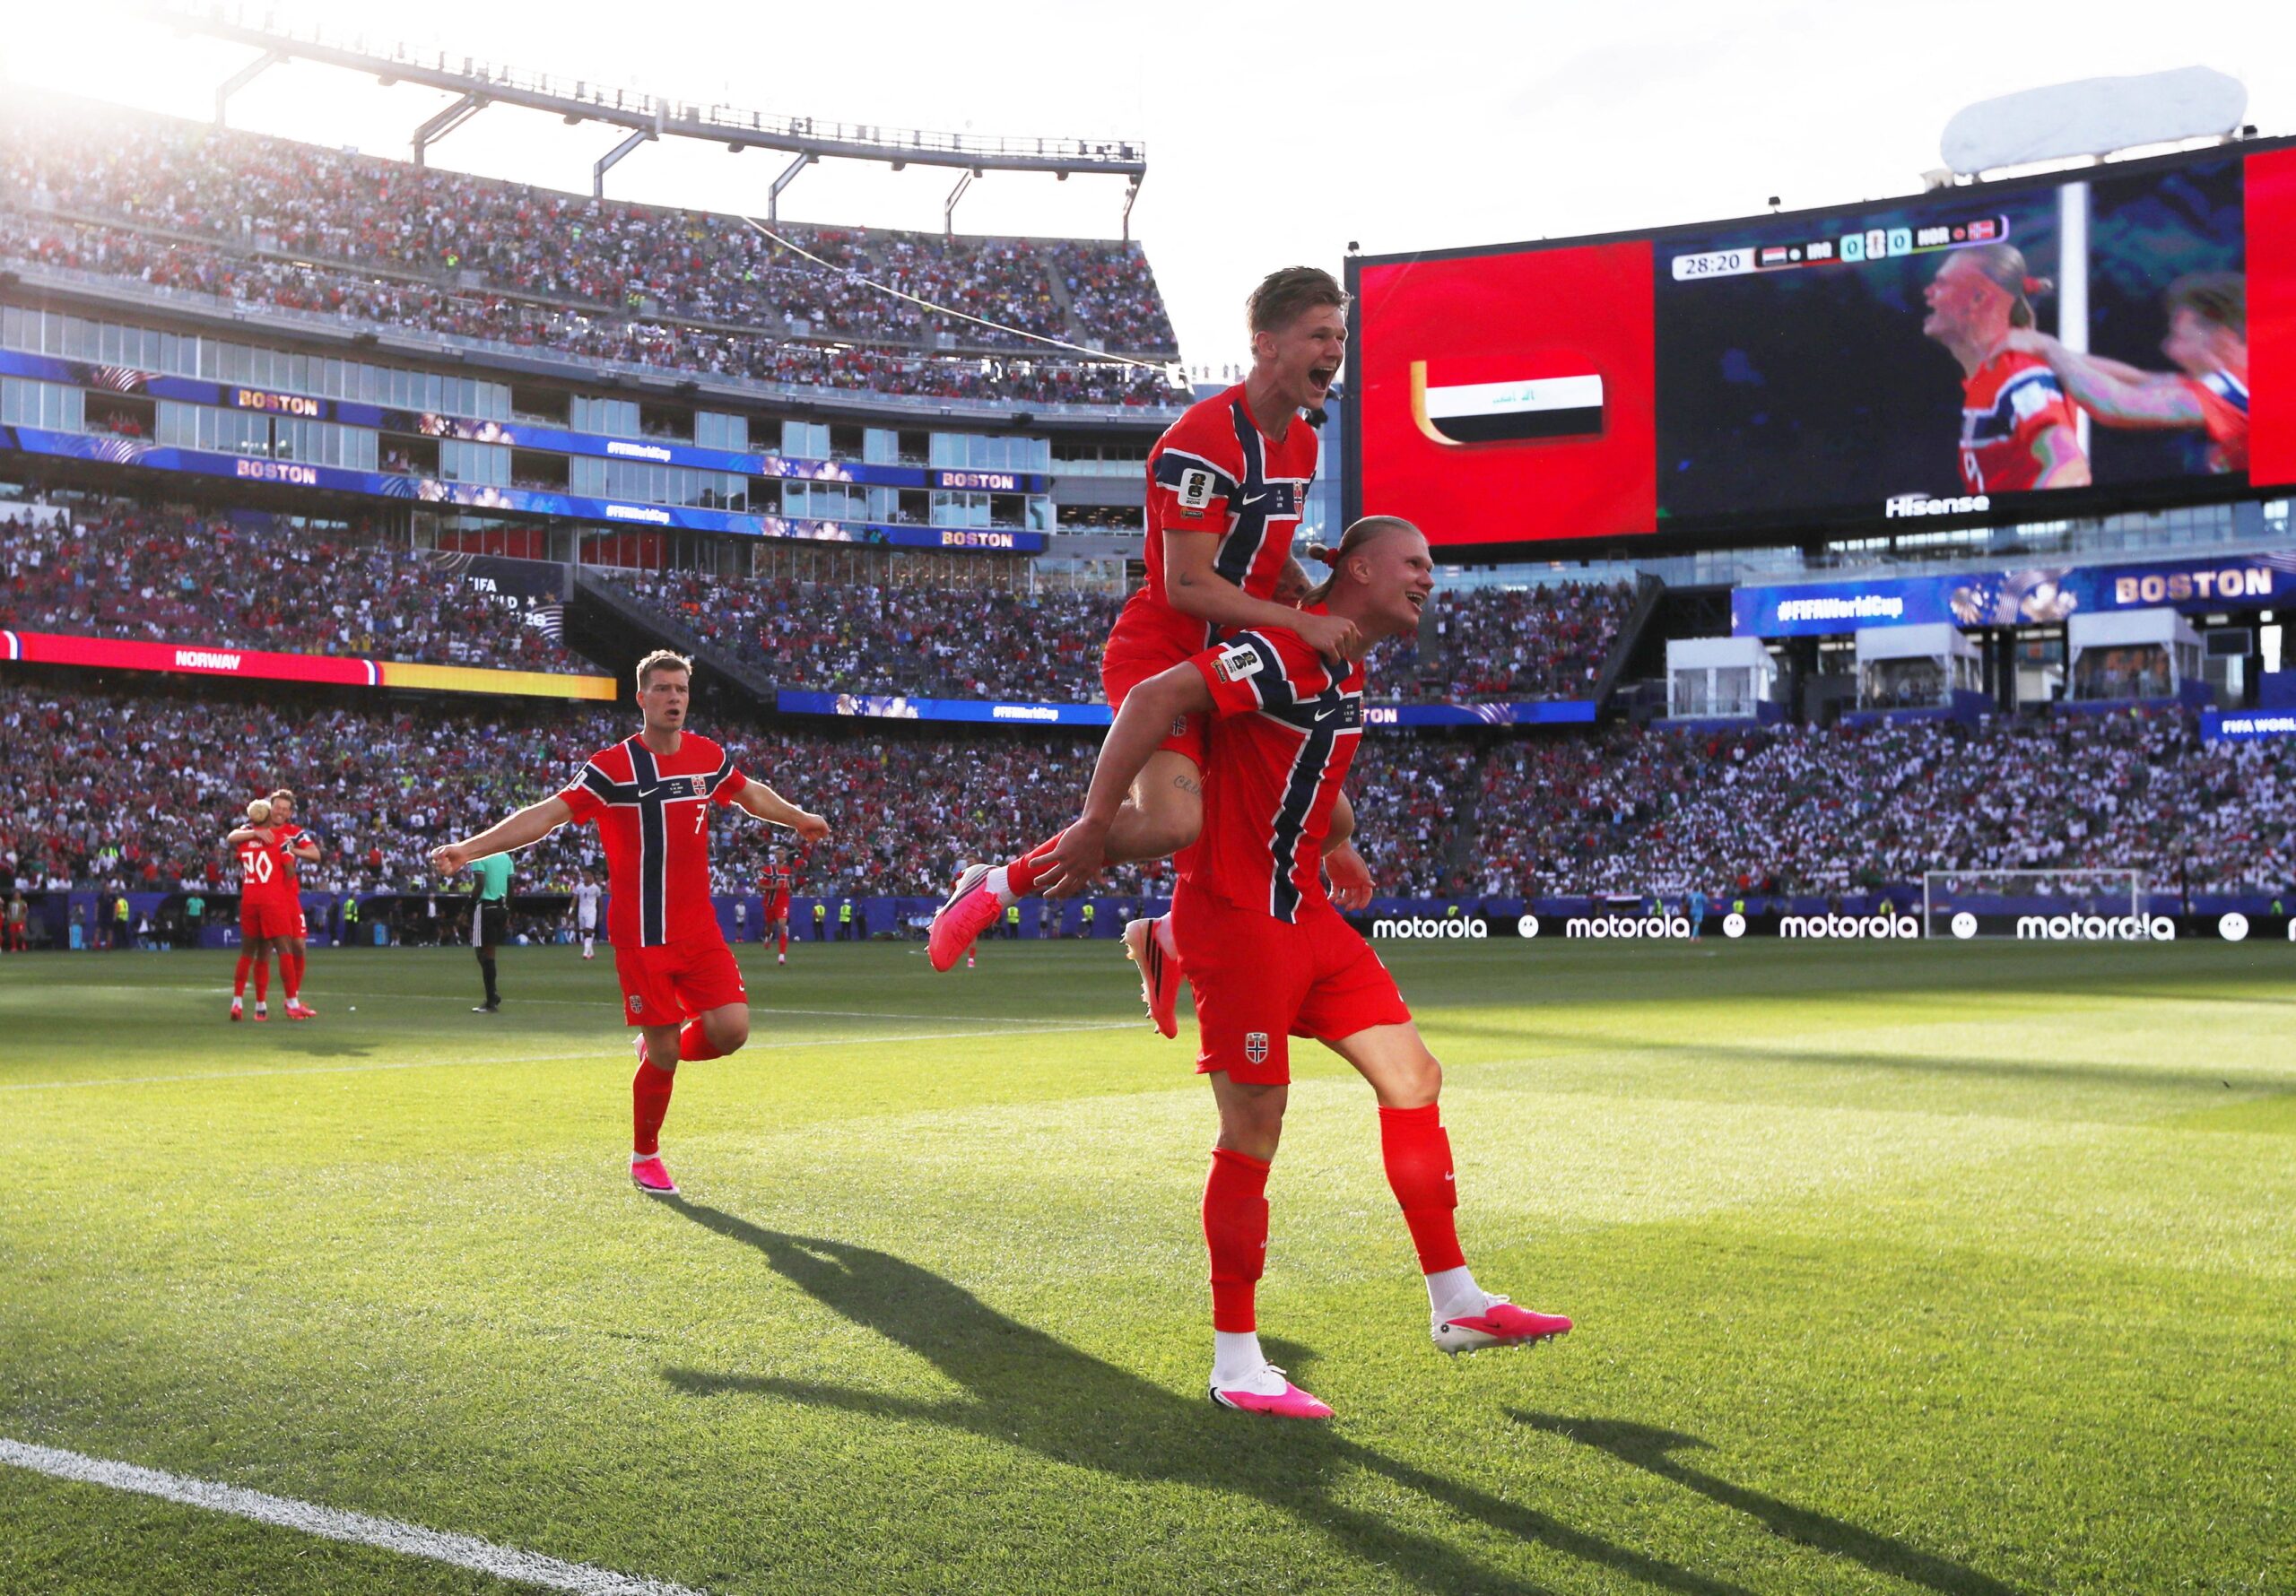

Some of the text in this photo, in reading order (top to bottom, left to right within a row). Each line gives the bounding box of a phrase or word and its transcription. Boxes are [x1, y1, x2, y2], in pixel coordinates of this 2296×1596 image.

[1685, 254, 1740, 274] 28:20
[239, 389, 318, 416] BOSTON
[237, 459, 317, 484] BOSTON
[943, 473, 1013, 489] BOSTON
[1885, 496, 1990, 517] Hisense
[942, 530, 1013, 547] BOSTON
[468, 577, 498, 593] IFA
[2116, 567, 2273, 604] BOSTON
[175, 650, 241, 671] NORWAY
[1363, 707, 1397, 724] TON
[2222, 716, 2296, 734] FIFA WORL
[694, 803, 707, 835] 7
[1372, 915, 1488, 939] motorola
[1566, 913, 1691, 939] motorola
[1779, 911, 1919, 939] motorola
[2016, 911, 2176, 941] motorola
